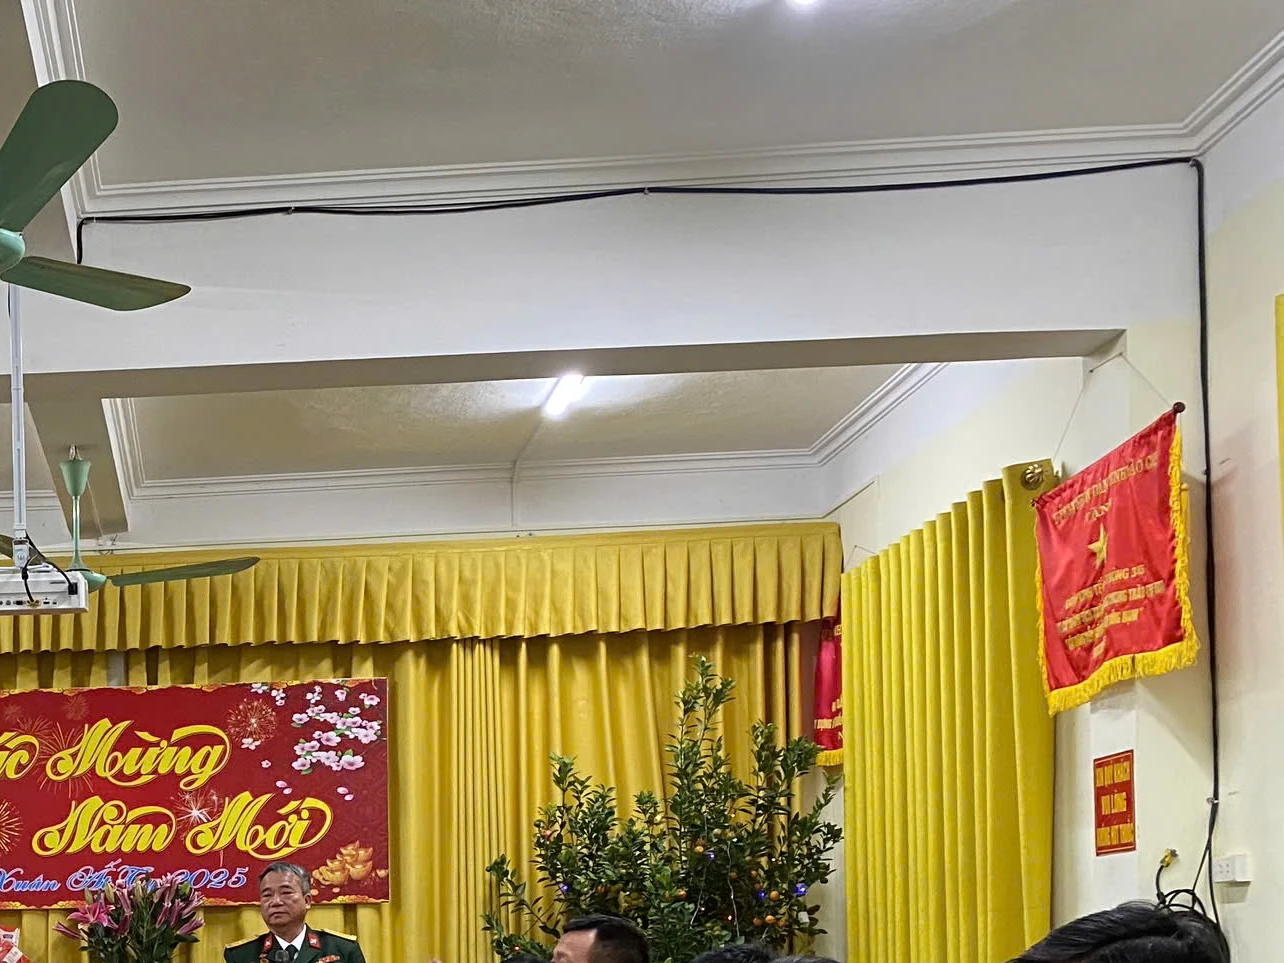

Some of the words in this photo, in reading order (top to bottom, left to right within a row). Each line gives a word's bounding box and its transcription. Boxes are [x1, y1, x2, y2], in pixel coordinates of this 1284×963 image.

[45, 717, 231, 791] Mừng
[32, 795, 177, 857] Năm
[185, 791, 333, 860] Mới
